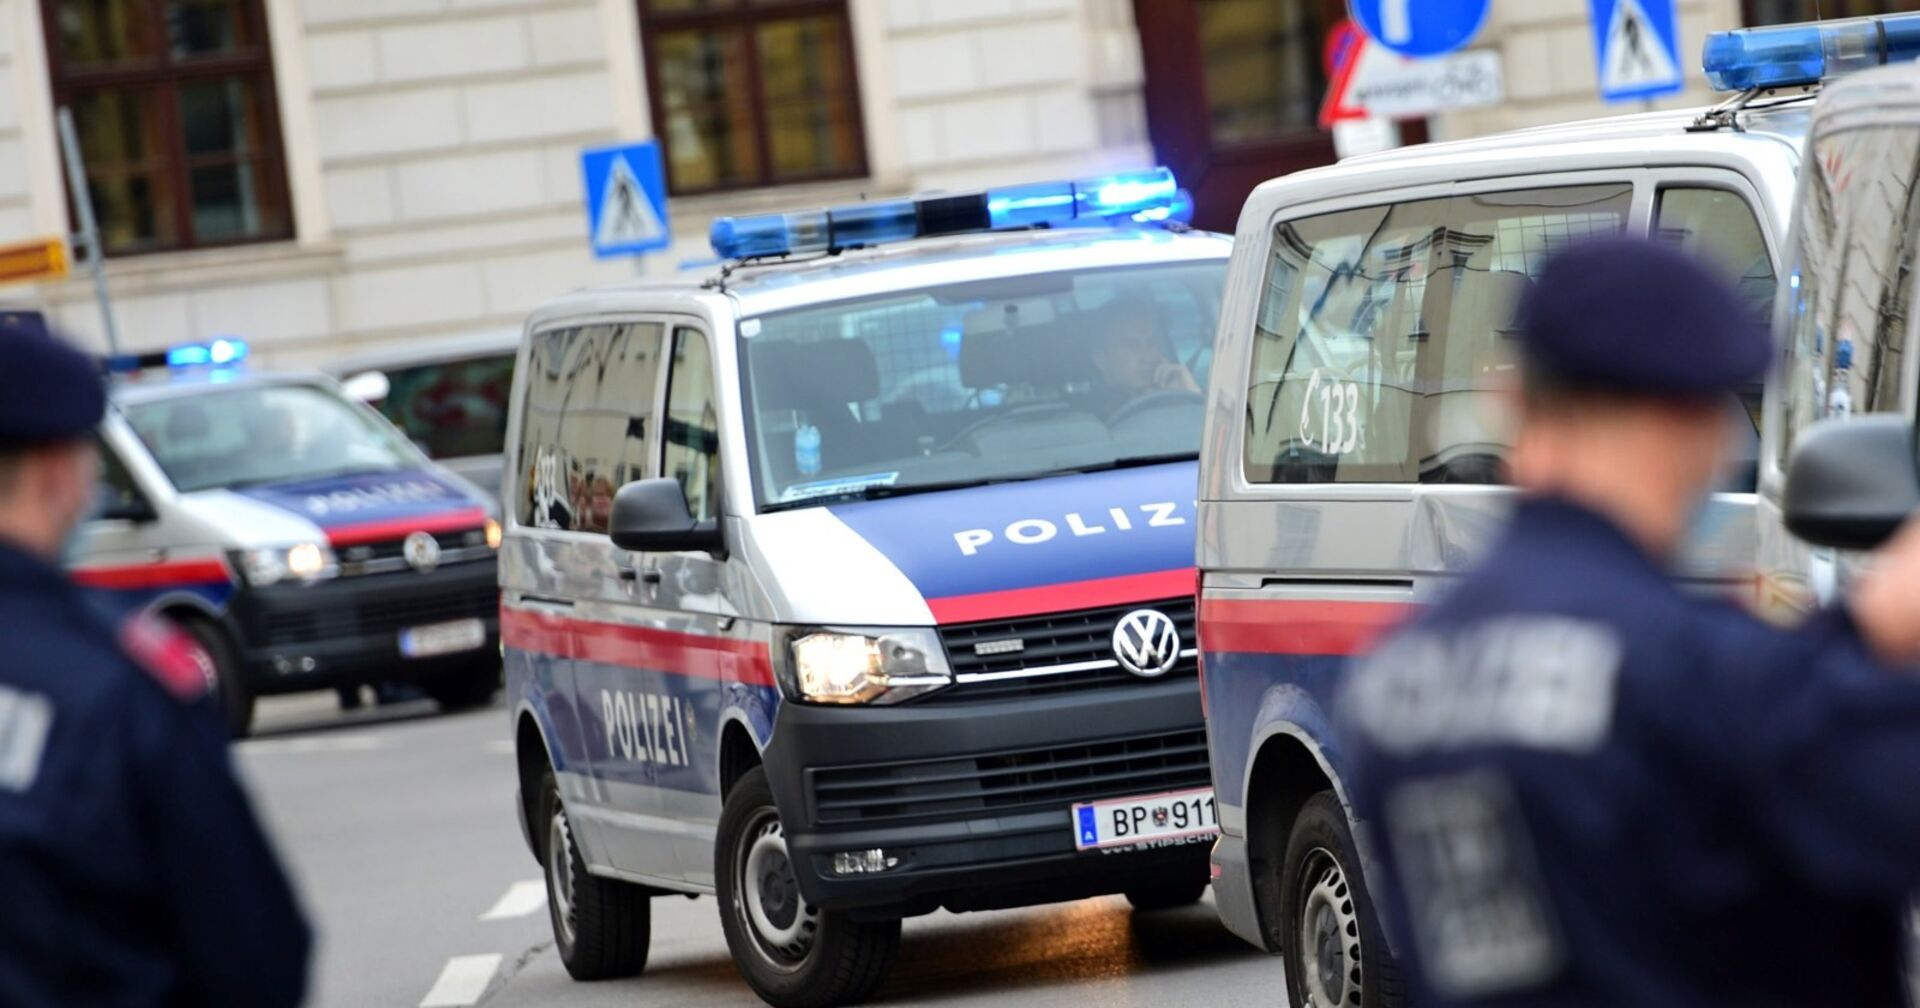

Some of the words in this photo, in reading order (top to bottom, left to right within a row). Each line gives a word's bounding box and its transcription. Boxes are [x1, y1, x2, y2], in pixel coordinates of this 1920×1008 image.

[1321, 383, 1358, 454] 133
[953, 500, 1198, 556] POLIZ
[602, 688, 689, 767] POLIZEI
[1113, 806, 1147, 837] BP
